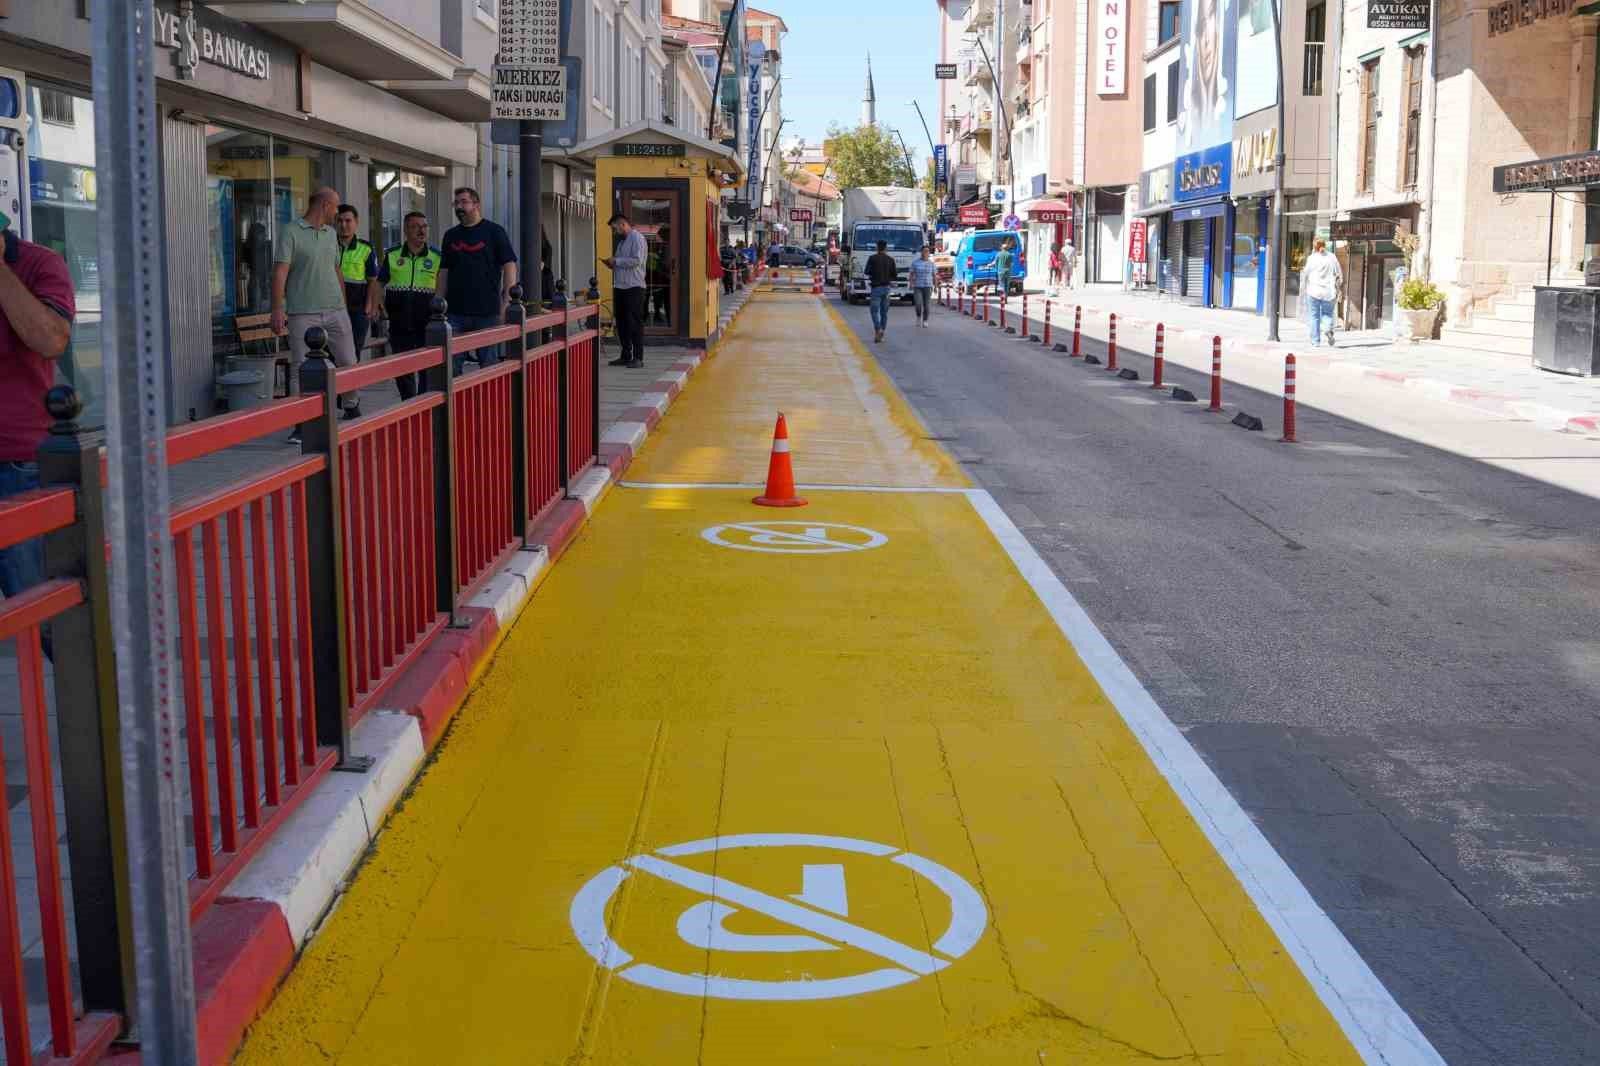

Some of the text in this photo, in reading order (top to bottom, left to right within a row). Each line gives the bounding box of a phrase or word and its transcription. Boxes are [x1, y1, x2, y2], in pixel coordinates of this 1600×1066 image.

[1370, 4, 1429, 14] AVUKAT
[495, 69, 561, 86] MERKEZ
[496, 107, 512, 117] Tel:
[515, 108, 532, 118] 215
[534, 109, 546, 118] 94
